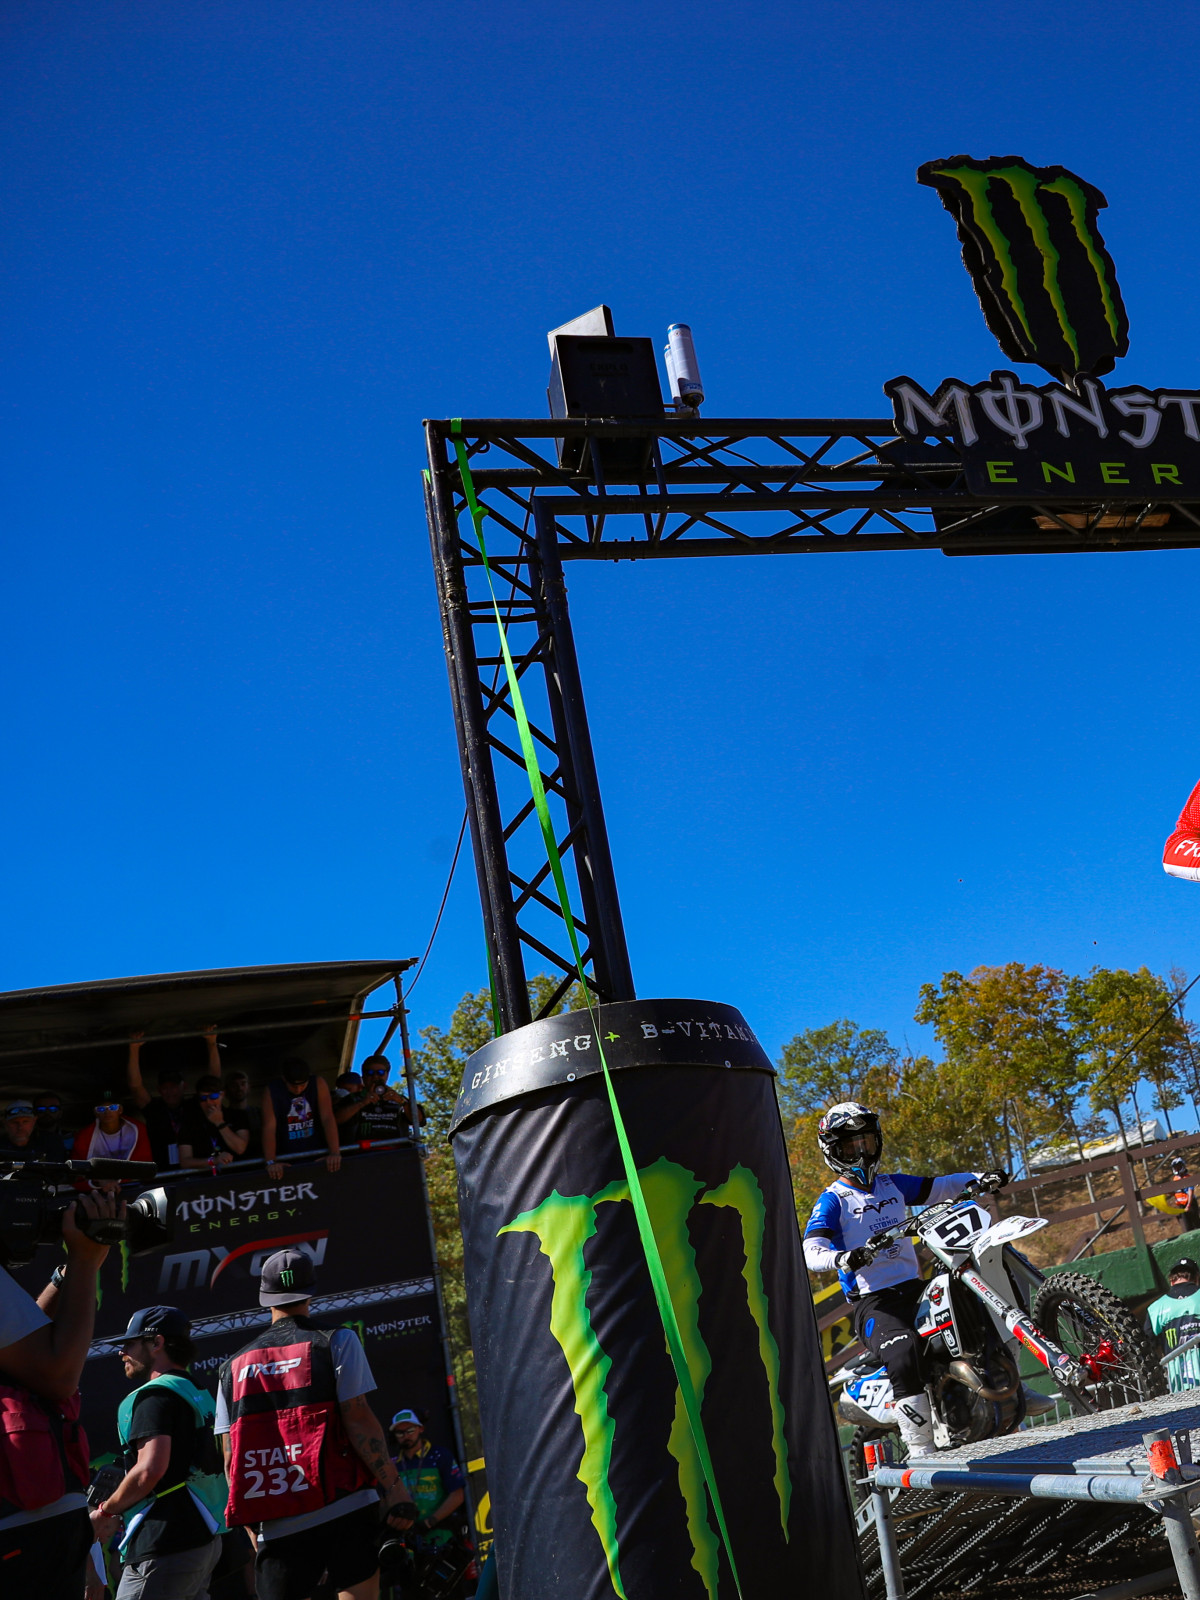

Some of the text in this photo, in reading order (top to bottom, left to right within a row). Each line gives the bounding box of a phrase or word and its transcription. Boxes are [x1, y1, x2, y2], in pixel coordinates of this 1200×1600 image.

[470, 1034, 592, 1090] GINSENG
[189, 1208, 298, 1233] ENERGY
[868, 1217, 899, 1232] ESTONIA
[933, 1207, 983, 1247] 57
[366, 1315, 433, 1336] MONSTER
[237, 1357, 302, 1383] MXGP
[857, 1379, 890, 1408] 57
[244, 1443, 303, 1468] STAFF
[243, 1464, 309, 1500] 232
